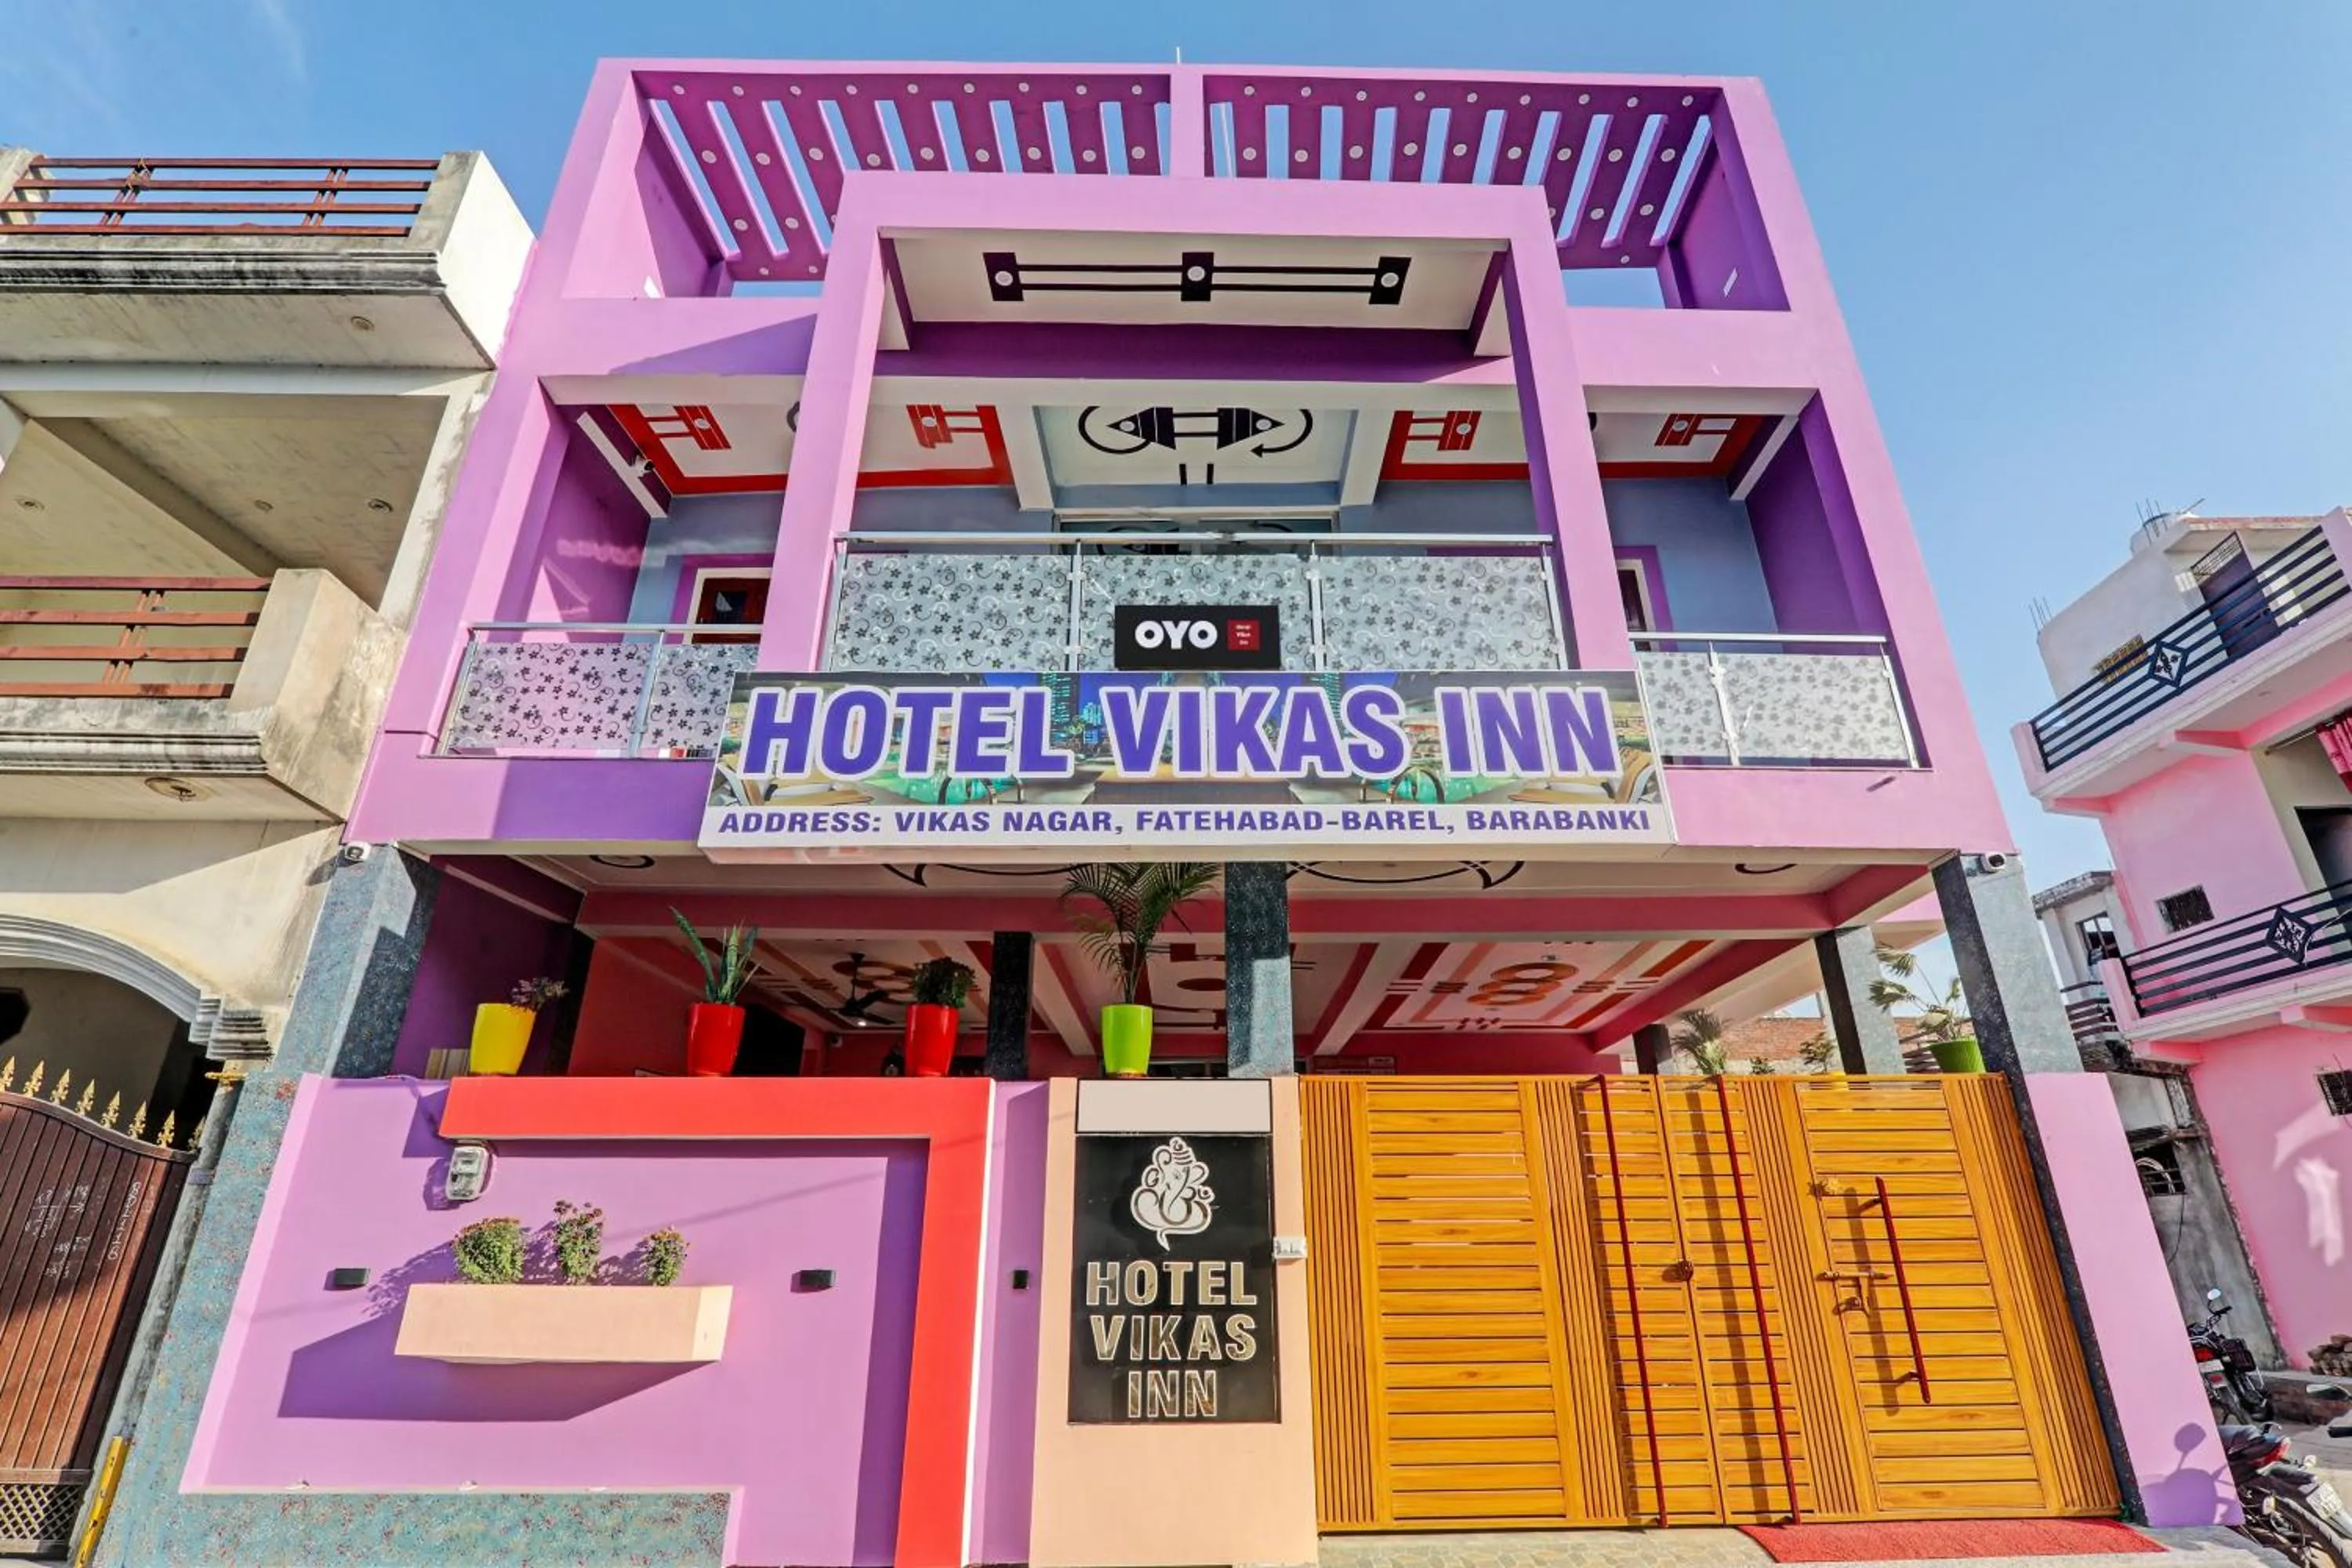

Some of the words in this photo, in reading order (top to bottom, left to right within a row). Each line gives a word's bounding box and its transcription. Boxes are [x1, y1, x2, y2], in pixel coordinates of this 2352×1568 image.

[1134, 620, 1218, 650] OYO
[739, 687, 1072, 779] HOTEL
[1102, 687, 1407, 779] VIKAS
[1436, 687, 1621, 779] INN
[718, 811, 881, 833] ADDRESS:
[895, 811, 989, 832] VIKAS
[1003, 811, 1123, 834] NAGAR,
[1136, 810, 1454, 834] FATEHABAD-BAREL,
[1466, 810, 1650, 830] BARABANKI
[1086, 1260, 1258, 1305] HOTEL
[1090, 1314, 1257, 1361] VIKAS
[1127, 1370, 1218, 1417] INN
